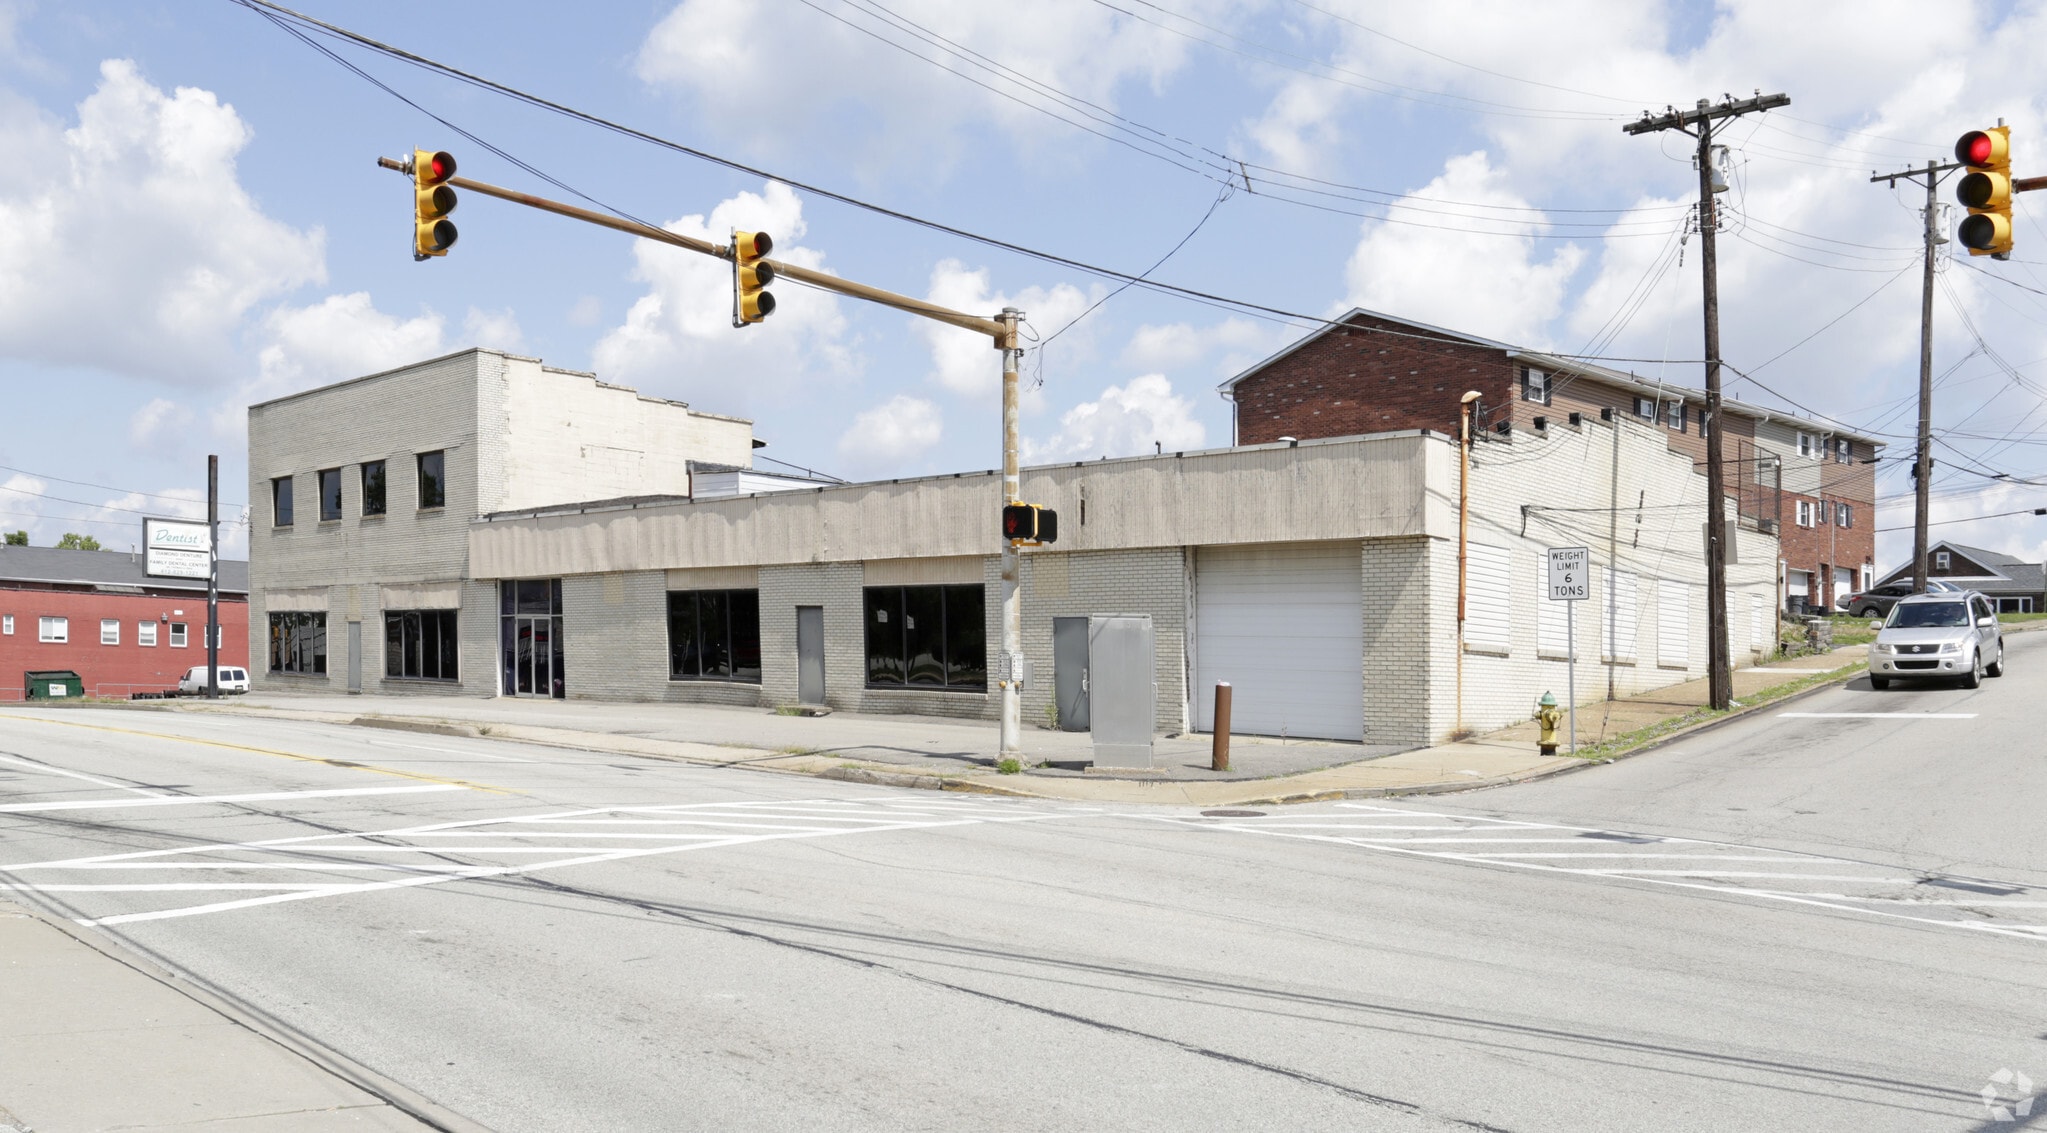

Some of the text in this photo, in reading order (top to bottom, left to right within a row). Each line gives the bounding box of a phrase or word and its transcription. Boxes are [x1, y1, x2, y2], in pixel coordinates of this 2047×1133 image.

[155, 529, 198, 544] Dentist
[1552, 551, 1584, 560] WEIGHT
[1557, 562, 1579, 570] LIMIT
[1565, 573, 1572, 583] 6
[1554, 586, 1584, 596] TONS
